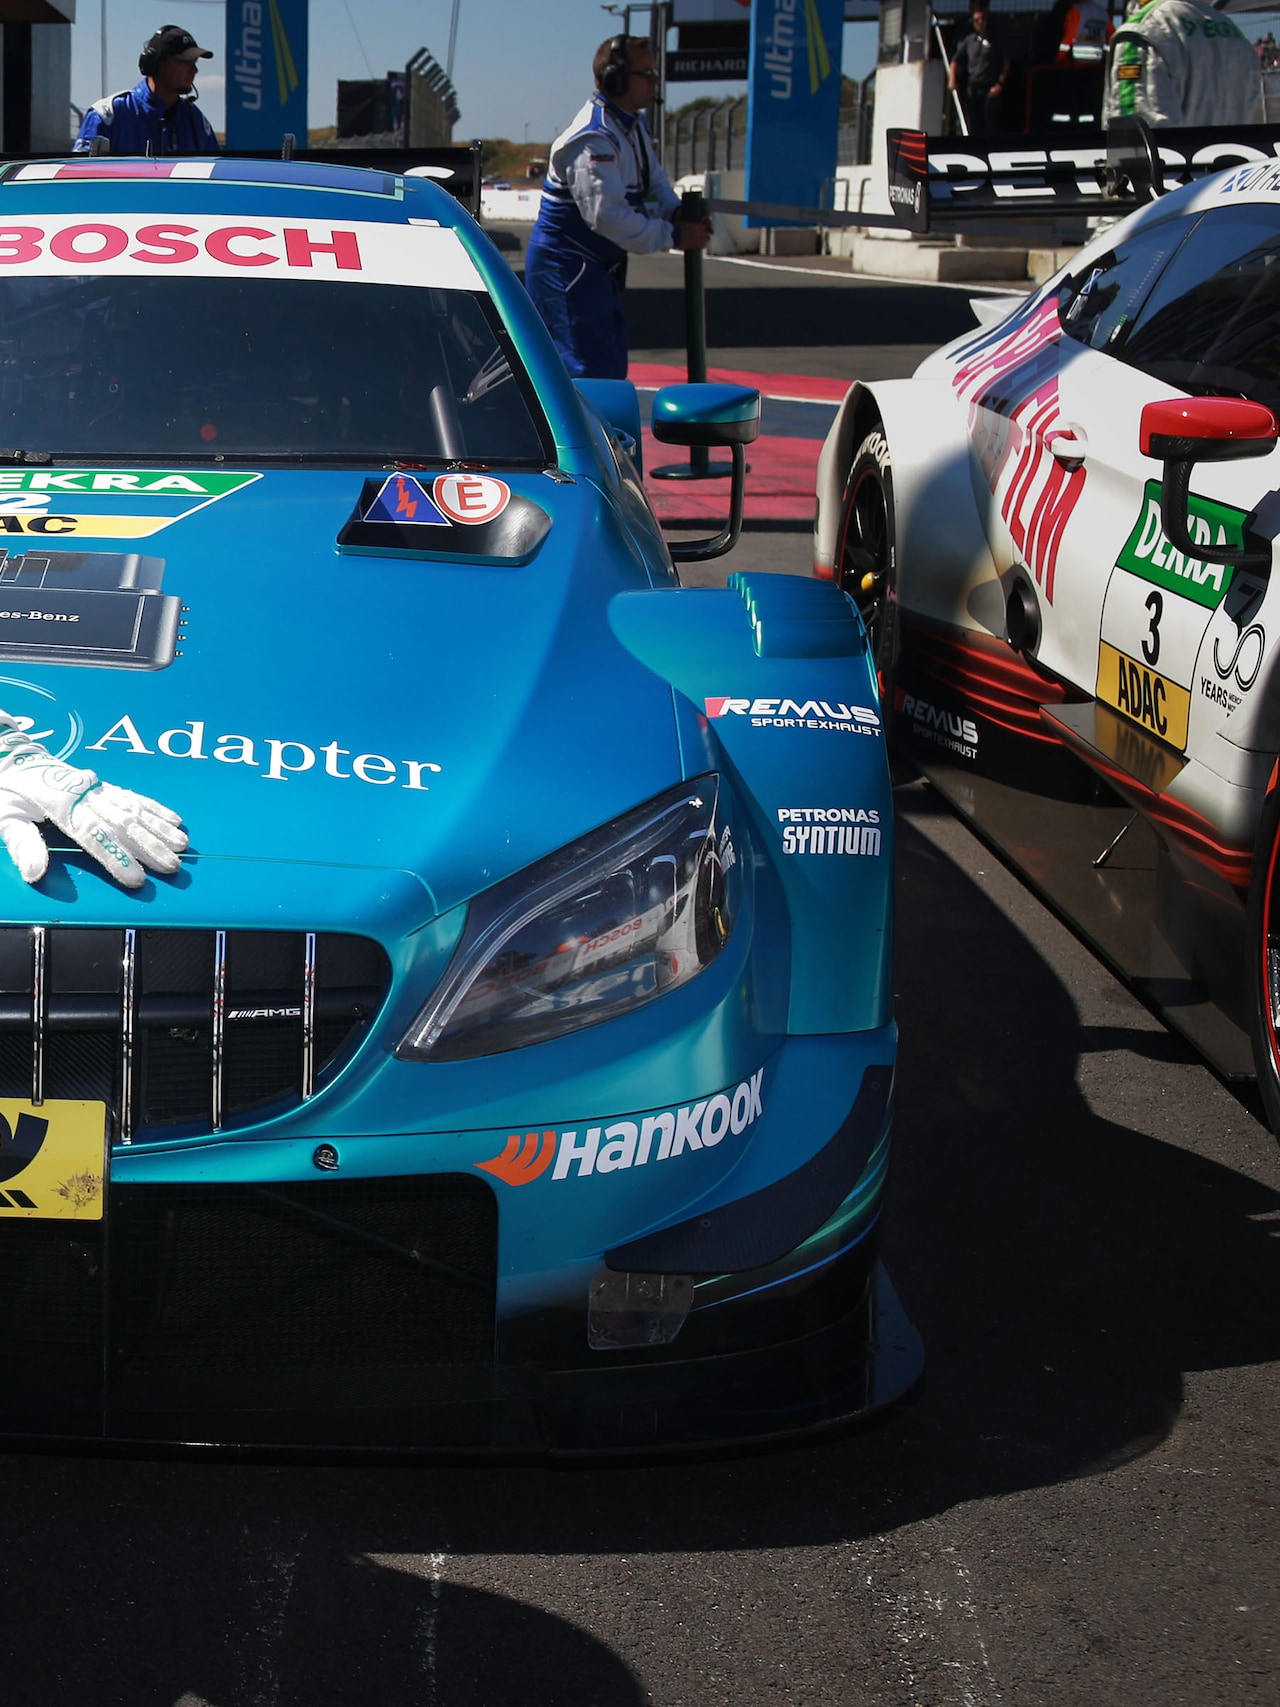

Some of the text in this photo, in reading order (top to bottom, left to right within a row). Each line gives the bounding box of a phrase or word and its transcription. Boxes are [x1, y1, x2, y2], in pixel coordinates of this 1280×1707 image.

[674, 59, 746, 73] RICHARD
[890, 185, 915, 206] PETRONAS
[456, 482, 487, 511] E
[1141, 591, 1164, 666] 3
[1118, 655, 1168, 736] ADAC
[1201, 676, 1228, 708] YEARS
[719, 698, 880, 726] REMUS
[902, 695, 979, 744] REMUS
[751, 718, 881, 737] SPORTEXHAUST
[912, 723, 978, 760] SPORTEXHAUST
[85, 714, 442, 791] Adapter
[777, 807, 880, 824] PETRONAS
[782, 825, 882, 857] SYNTIUM
[251, 1007, 301, 1018] AMG
